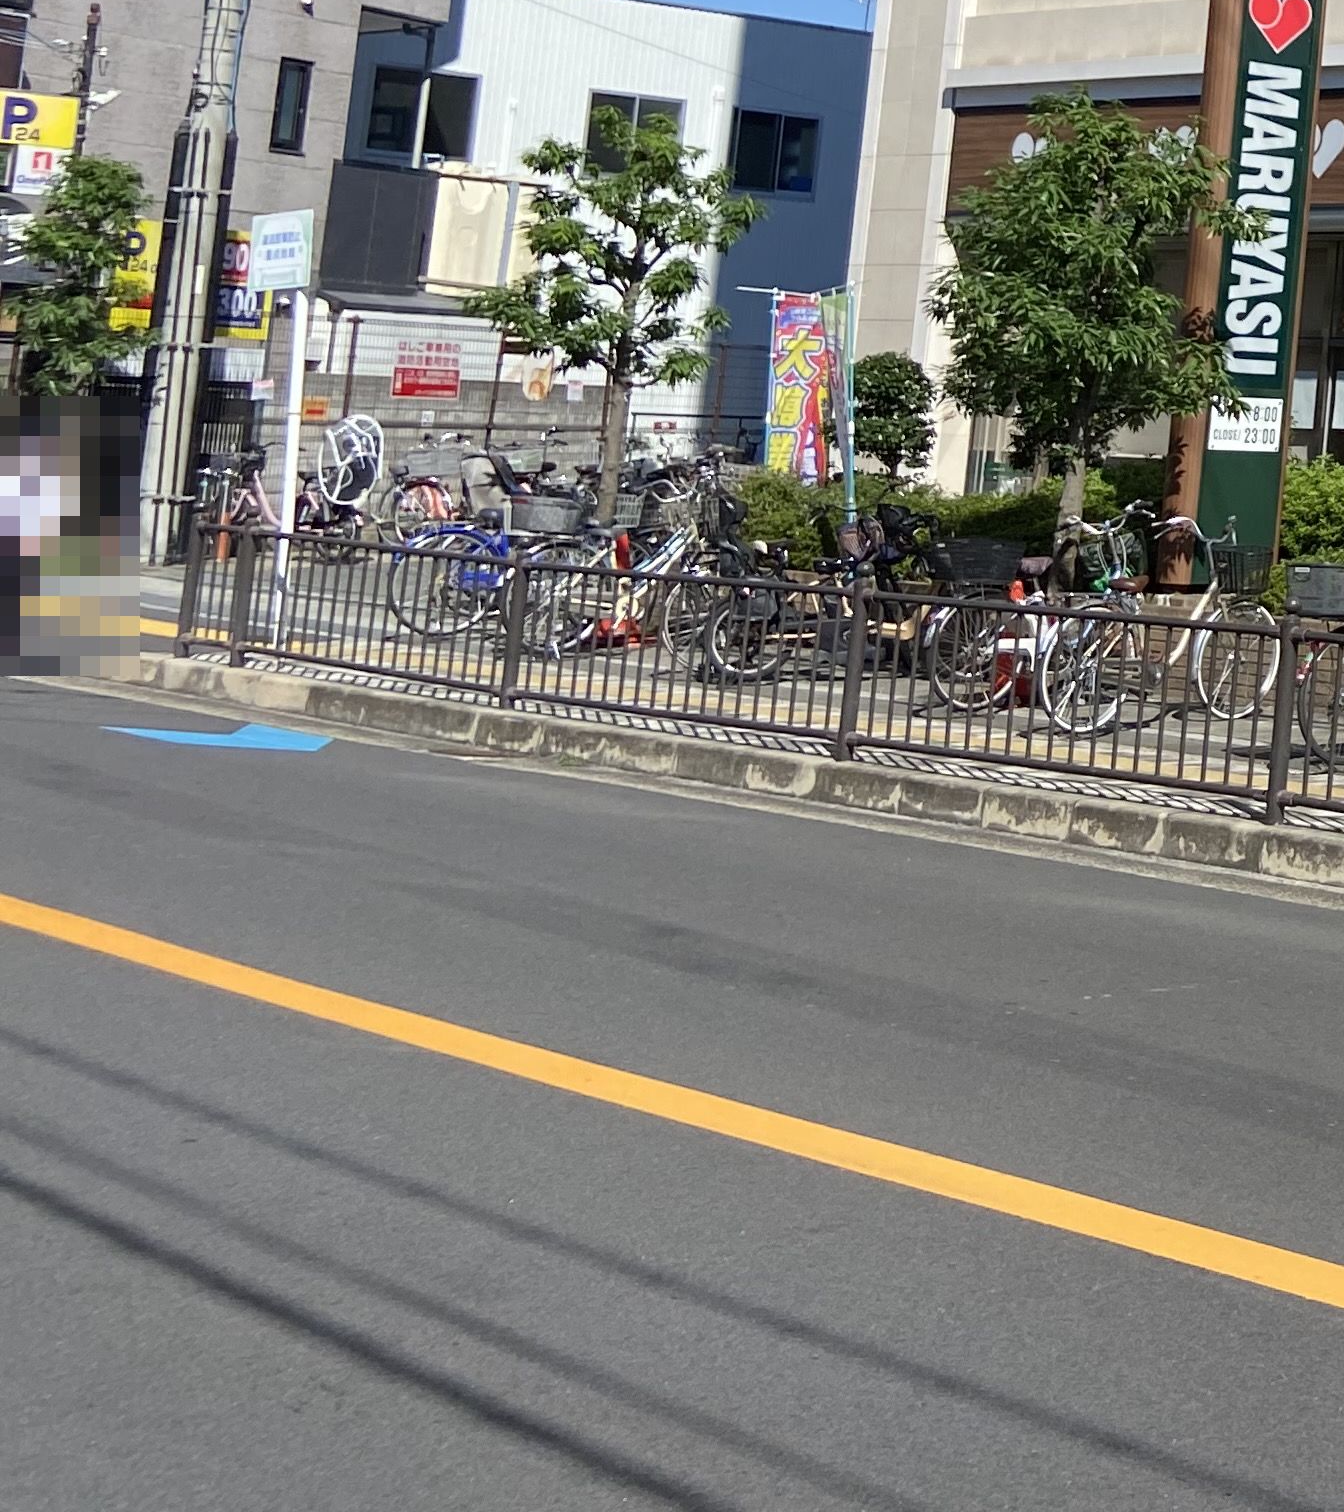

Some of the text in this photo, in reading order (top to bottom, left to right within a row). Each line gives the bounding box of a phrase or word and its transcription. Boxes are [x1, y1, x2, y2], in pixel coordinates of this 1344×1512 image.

[2, 95, 41, 141] P 24
[1225, 60, 1303, 376] MARUYASU
[222, 242, 250, 272] 90
[1253, 406, 1278, 423] 8:00
[1244, 428, 1276, 445] 23:00
